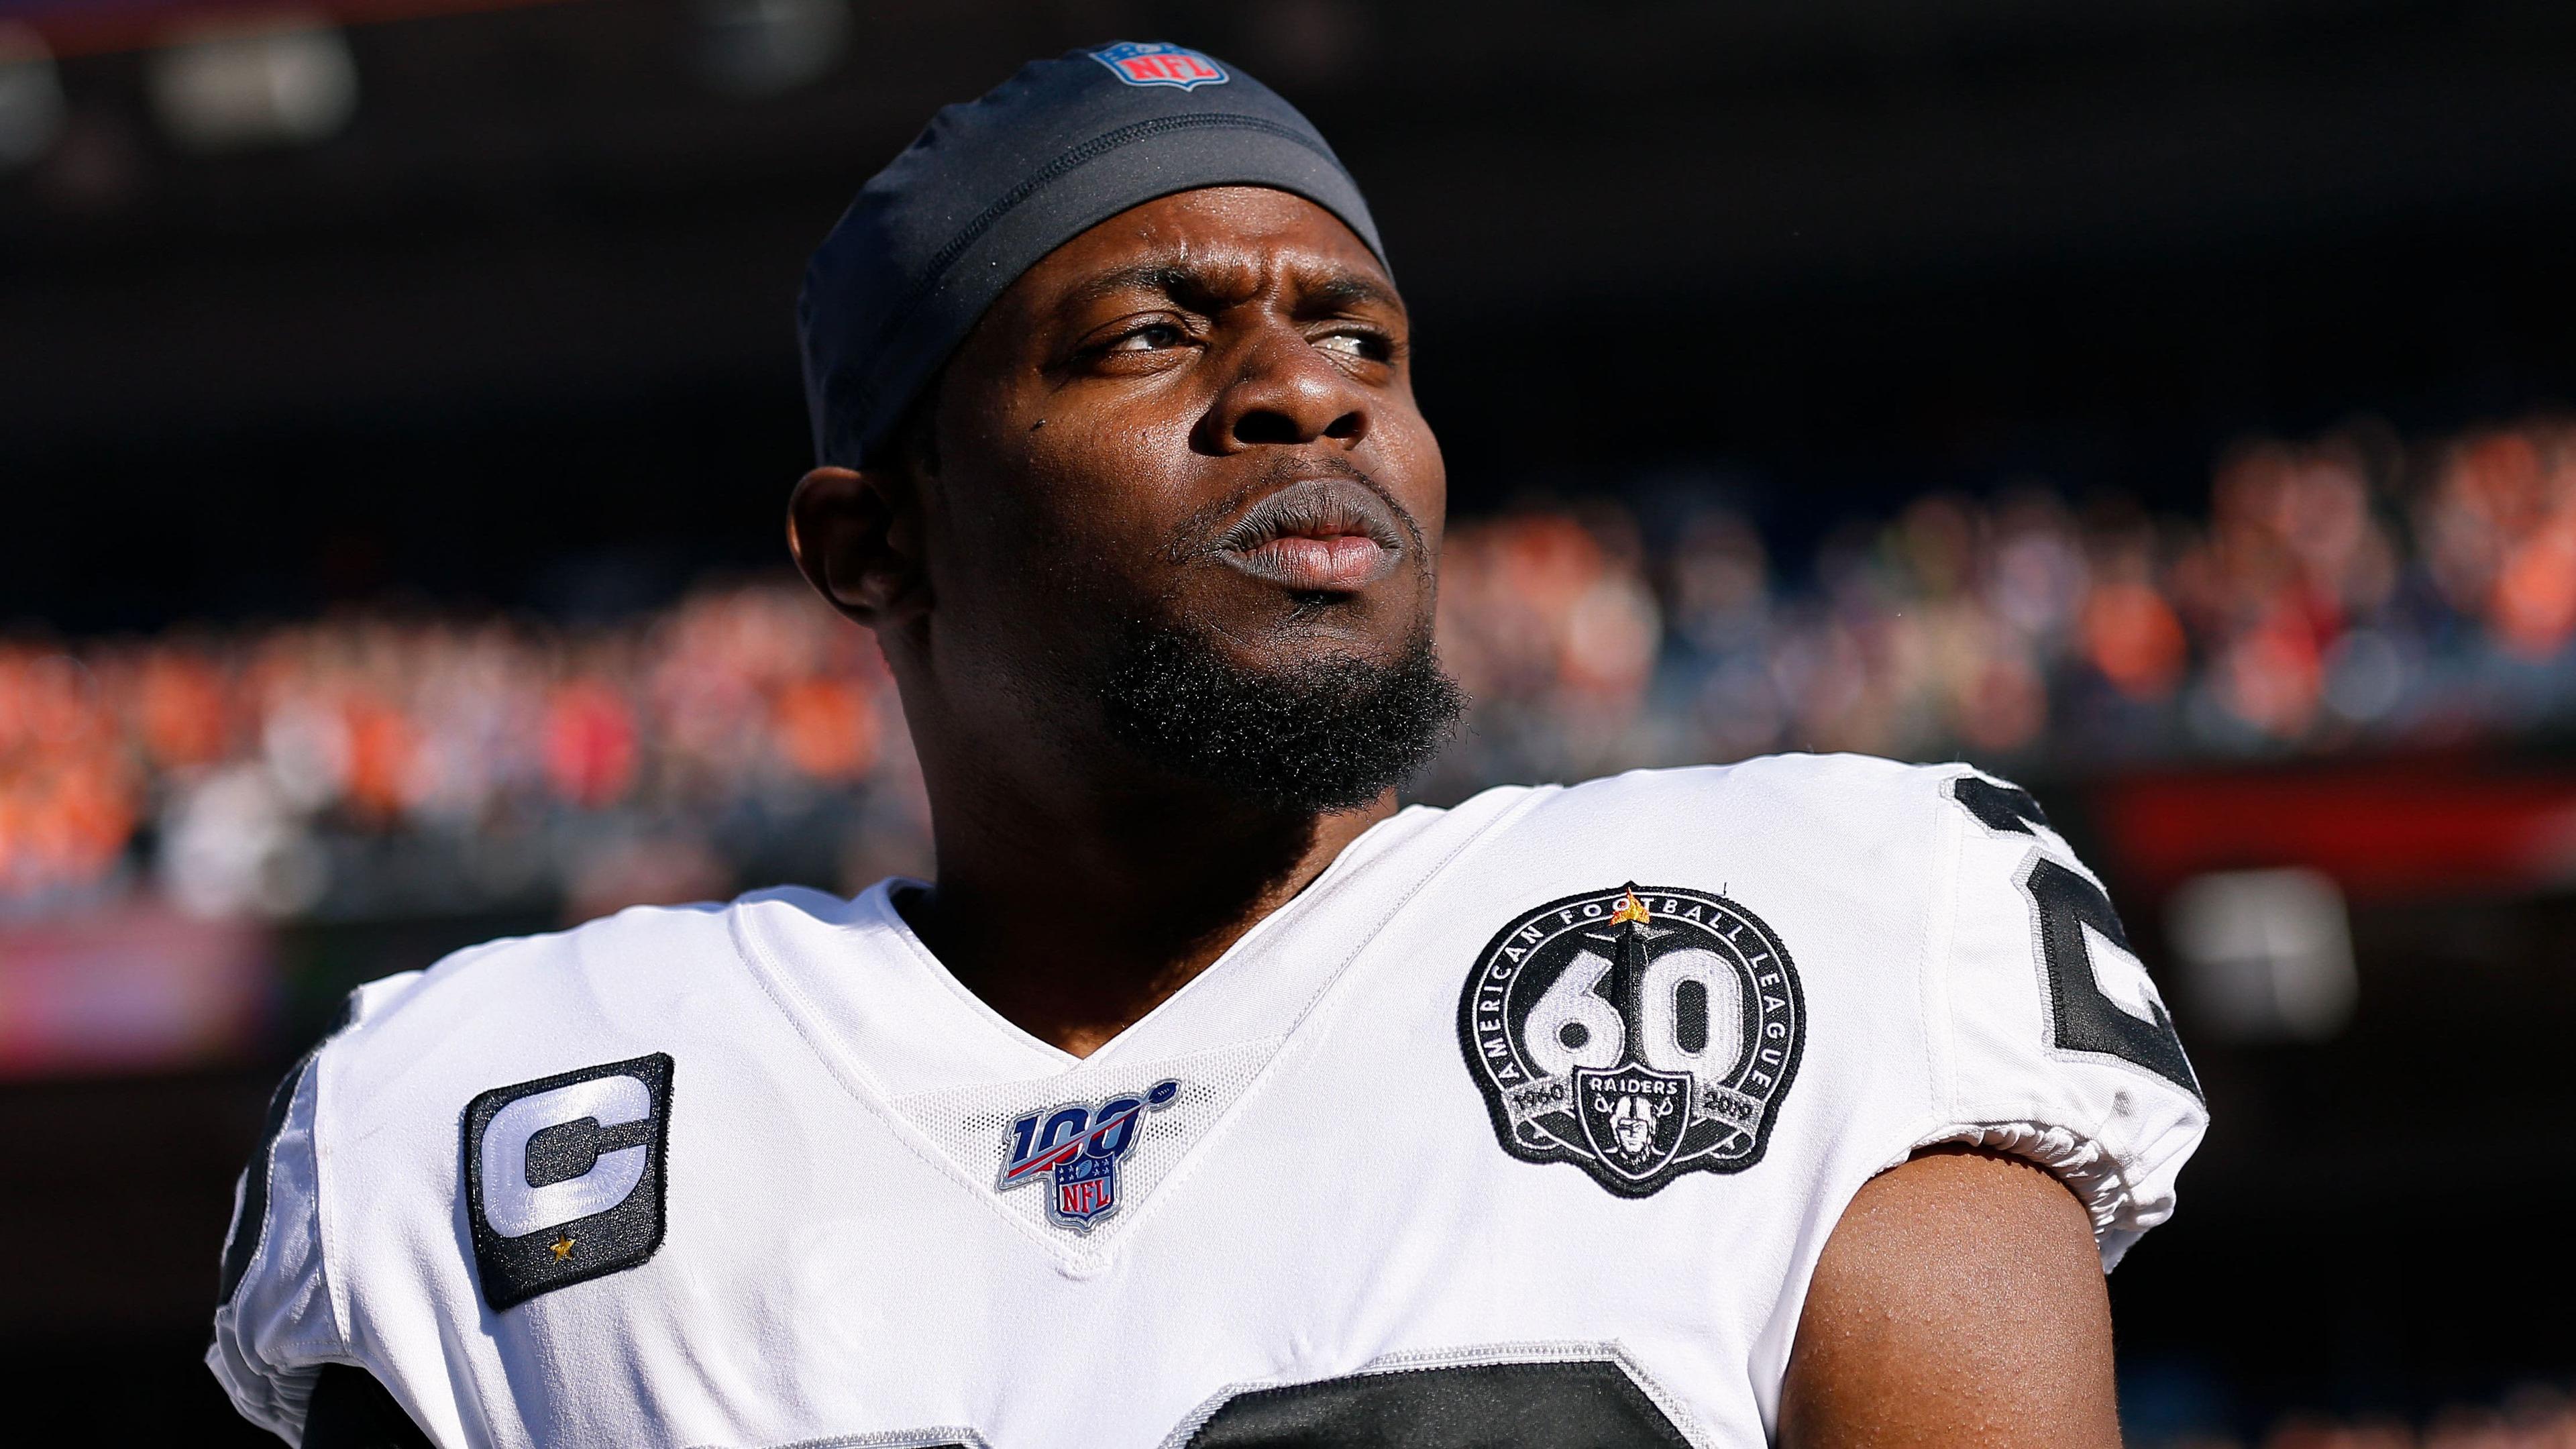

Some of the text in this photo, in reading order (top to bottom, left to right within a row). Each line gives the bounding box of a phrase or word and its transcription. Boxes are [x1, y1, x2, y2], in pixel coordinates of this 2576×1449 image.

[1117, 54, 1219, 80] NFL
[1479, 897, 1786, 1089] AMERICAN FOOTBALL LEAGUE
[1523, 948, 1745, 1083] 60
[1513, 1084, 1564, 1110] 1960
[1590, 1077, 1678, 1095] RAIDERS
[480, 1074, 652, 1238] C
[1007, 1098, 1142, 1173] 100
[1062, 1178, 1111, 1214] NFL
